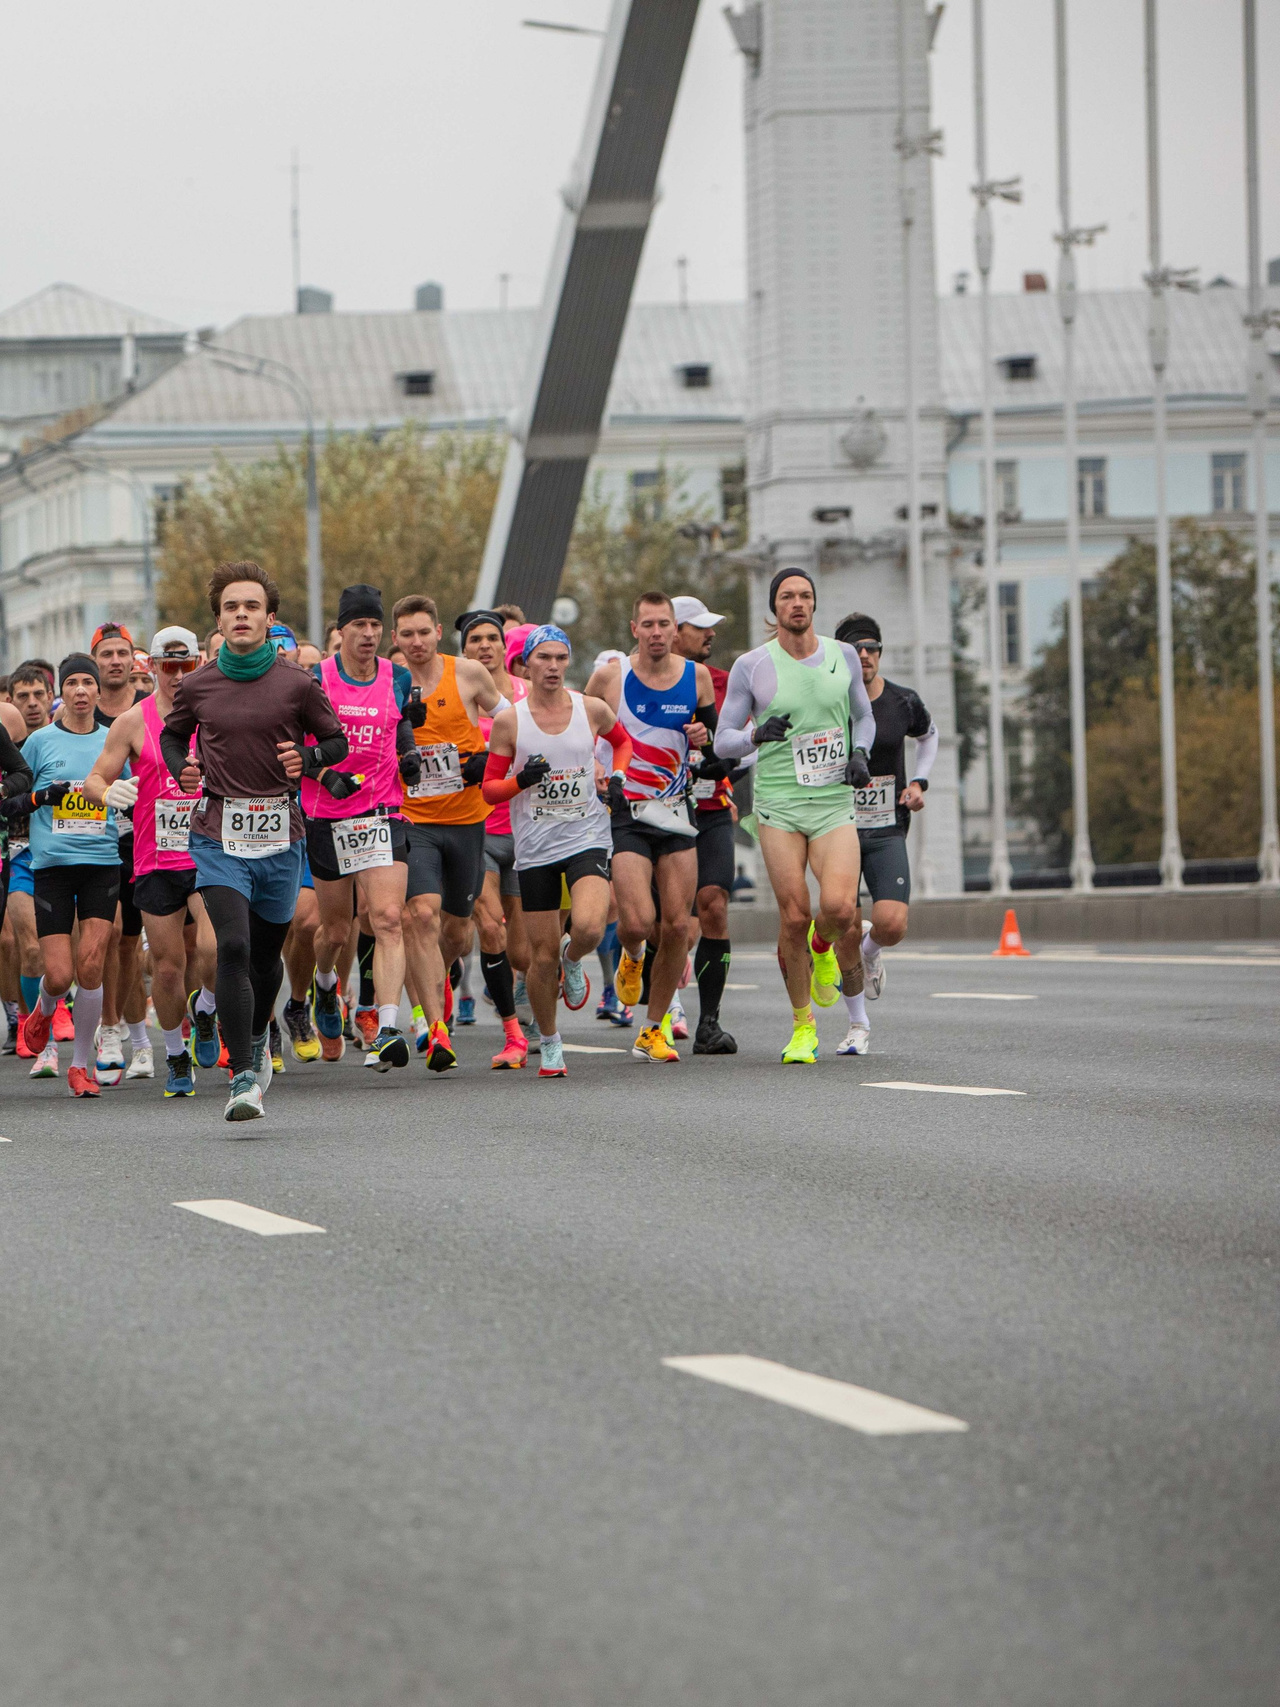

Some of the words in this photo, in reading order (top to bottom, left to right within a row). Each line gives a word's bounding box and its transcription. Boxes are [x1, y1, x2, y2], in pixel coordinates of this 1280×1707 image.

[797, 742, 845, 766] 15762
[538, 781, 581, 799] 3696
[853, 790, 886, 806] 321
[231, 812, 282, 832] 8123
[337, 828, 389, 850] 15970
